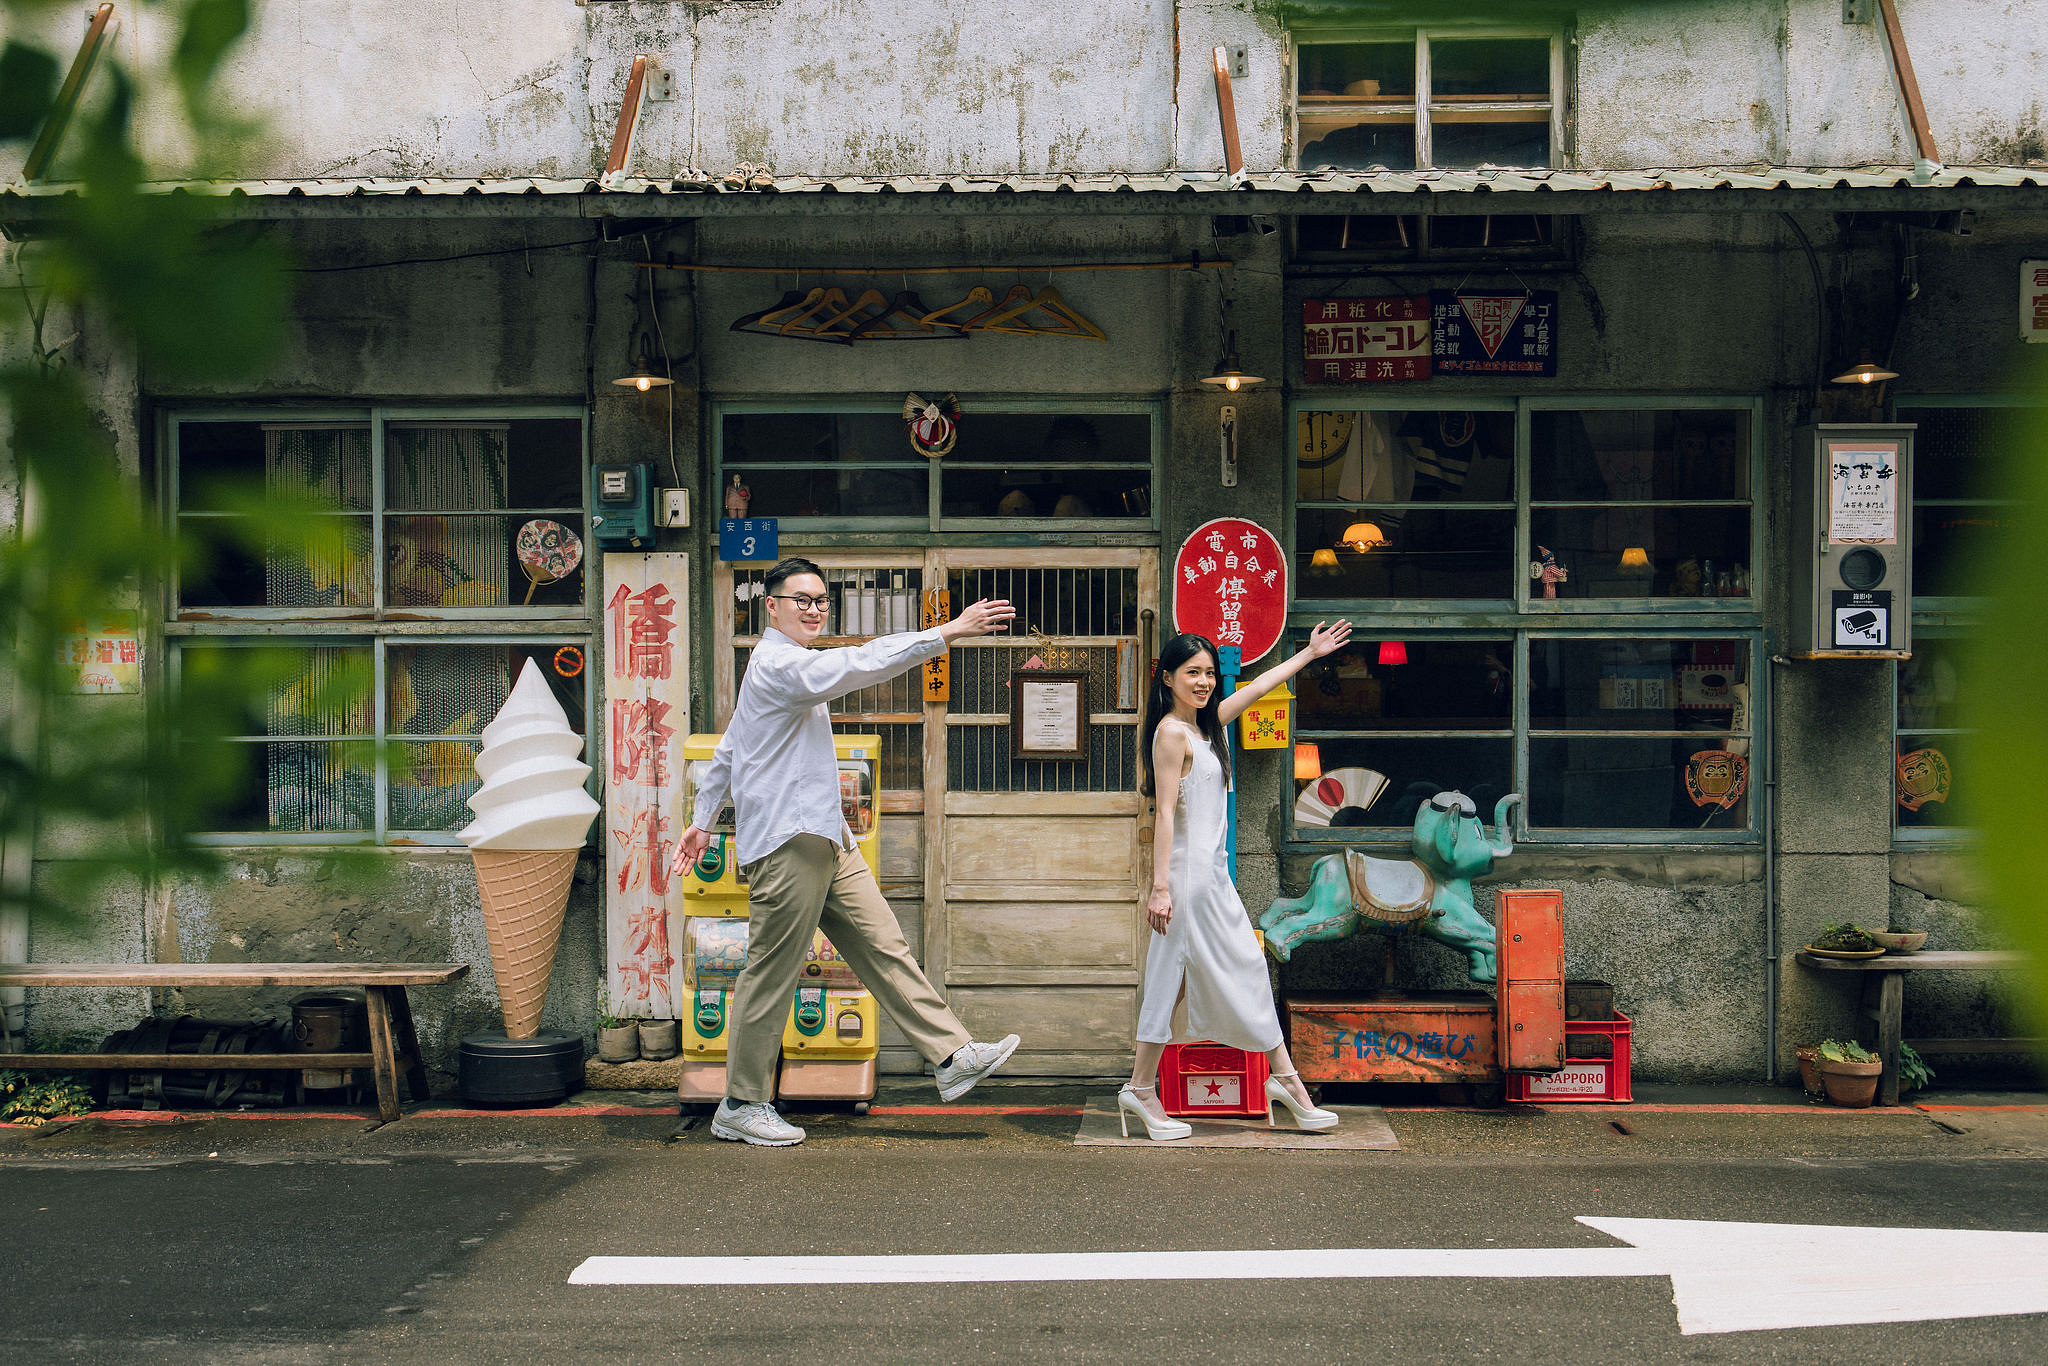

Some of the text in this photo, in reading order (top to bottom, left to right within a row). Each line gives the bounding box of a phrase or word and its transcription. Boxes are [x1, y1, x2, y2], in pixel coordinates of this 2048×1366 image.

[726, 520, 771, 532] 安西街
[741, 536, 756, 556] 3
[1215, 576, 1247, 645] 停留場
[1248, 729, 1287, 742] 牛乳
[1322, 1029, 1479, 1060] 子供の遊び
[1229, 1078, 1238, 1086] 20
[1546, 1072, 1604, 1084] SAPPORO
